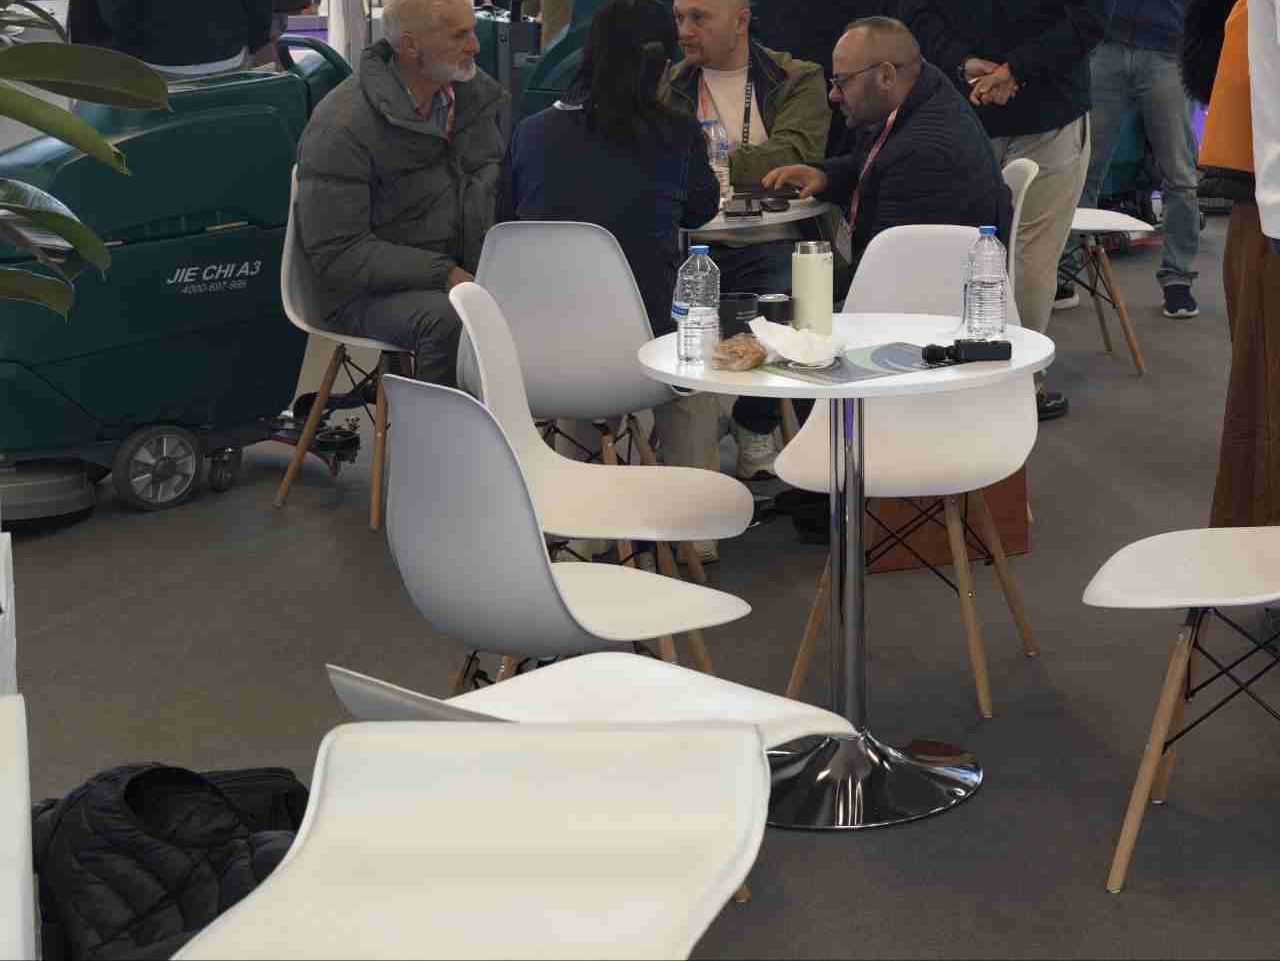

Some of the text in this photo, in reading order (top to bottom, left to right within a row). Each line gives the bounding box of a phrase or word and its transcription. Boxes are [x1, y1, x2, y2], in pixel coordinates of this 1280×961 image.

[166, 260, 262, 284] JIE CHI A3
